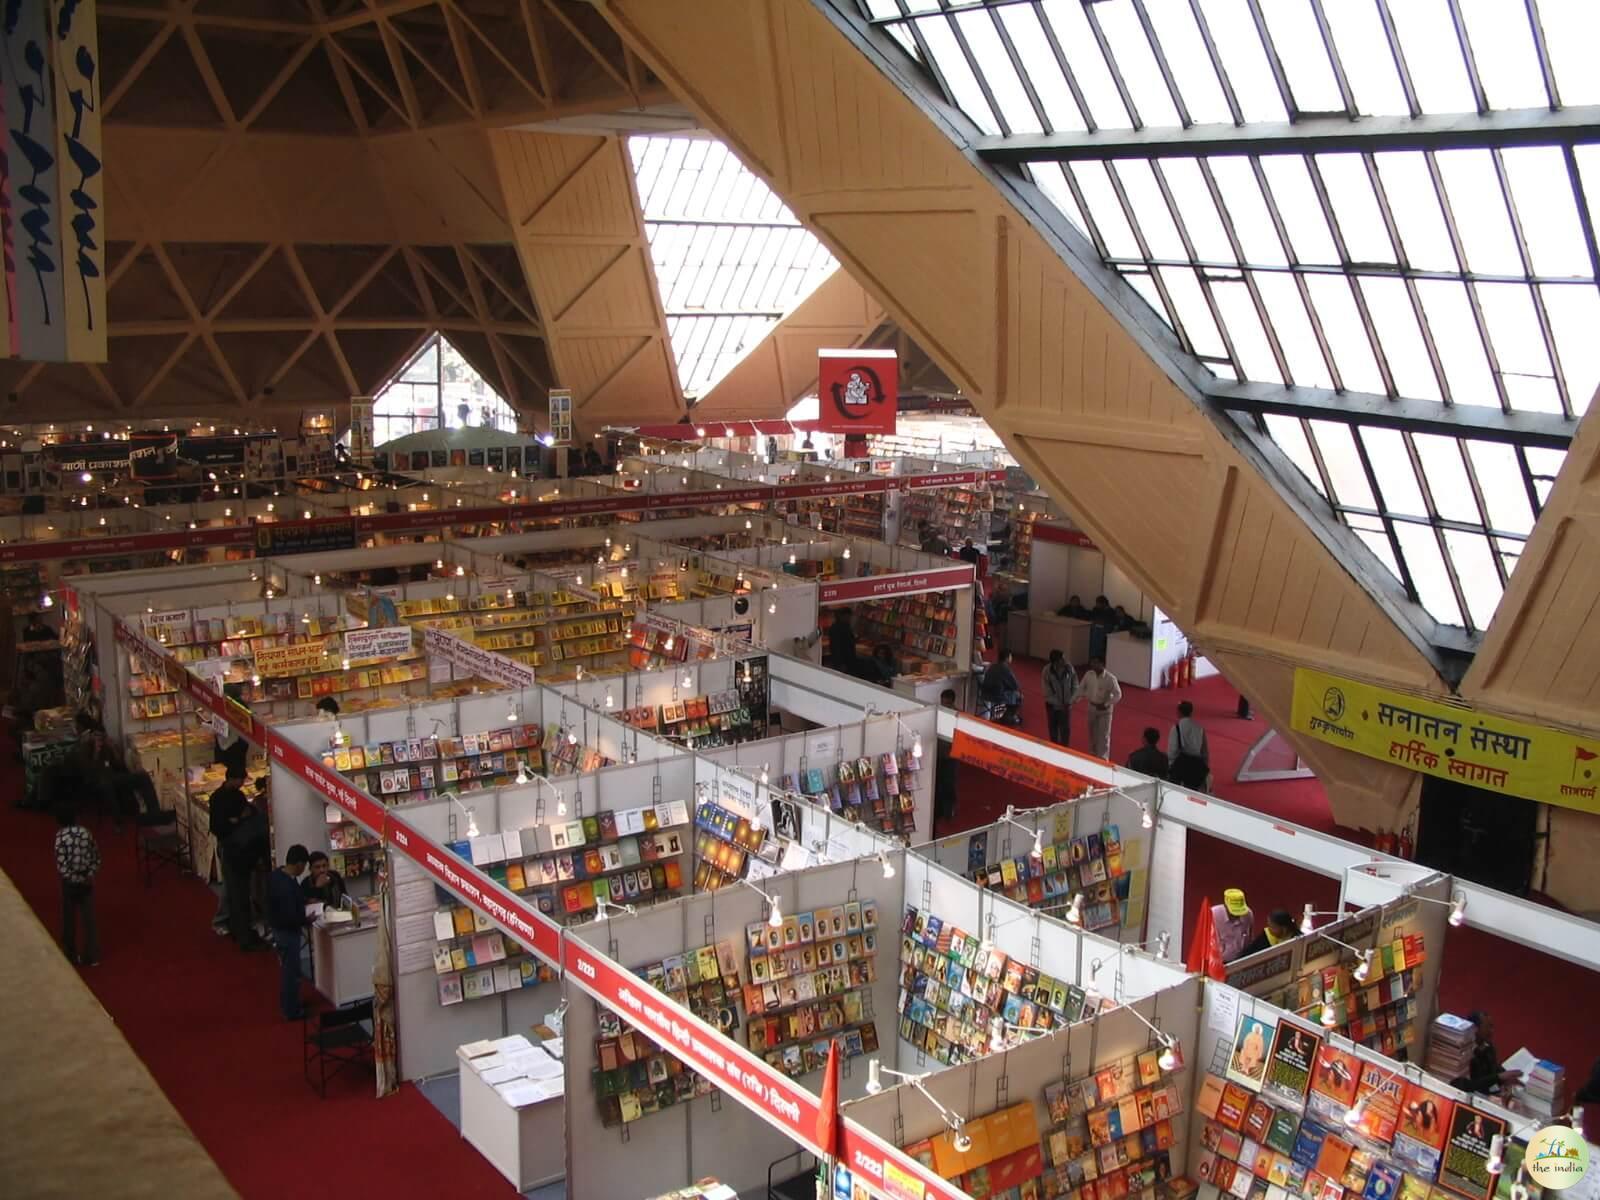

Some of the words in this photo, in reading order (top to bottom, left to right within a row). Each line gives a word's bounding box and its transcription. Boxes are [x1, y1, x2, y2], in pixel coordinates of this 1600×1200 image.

[1378, 702, 1462, 745] सनातन
[1470, 720, 1531, 760] संस्था
[1389, 739, 1440, 768] हार्दिक
[1447, 757, 1509, 788] स्वागत
[768, 1086, 801, 1124] दिल्ली
